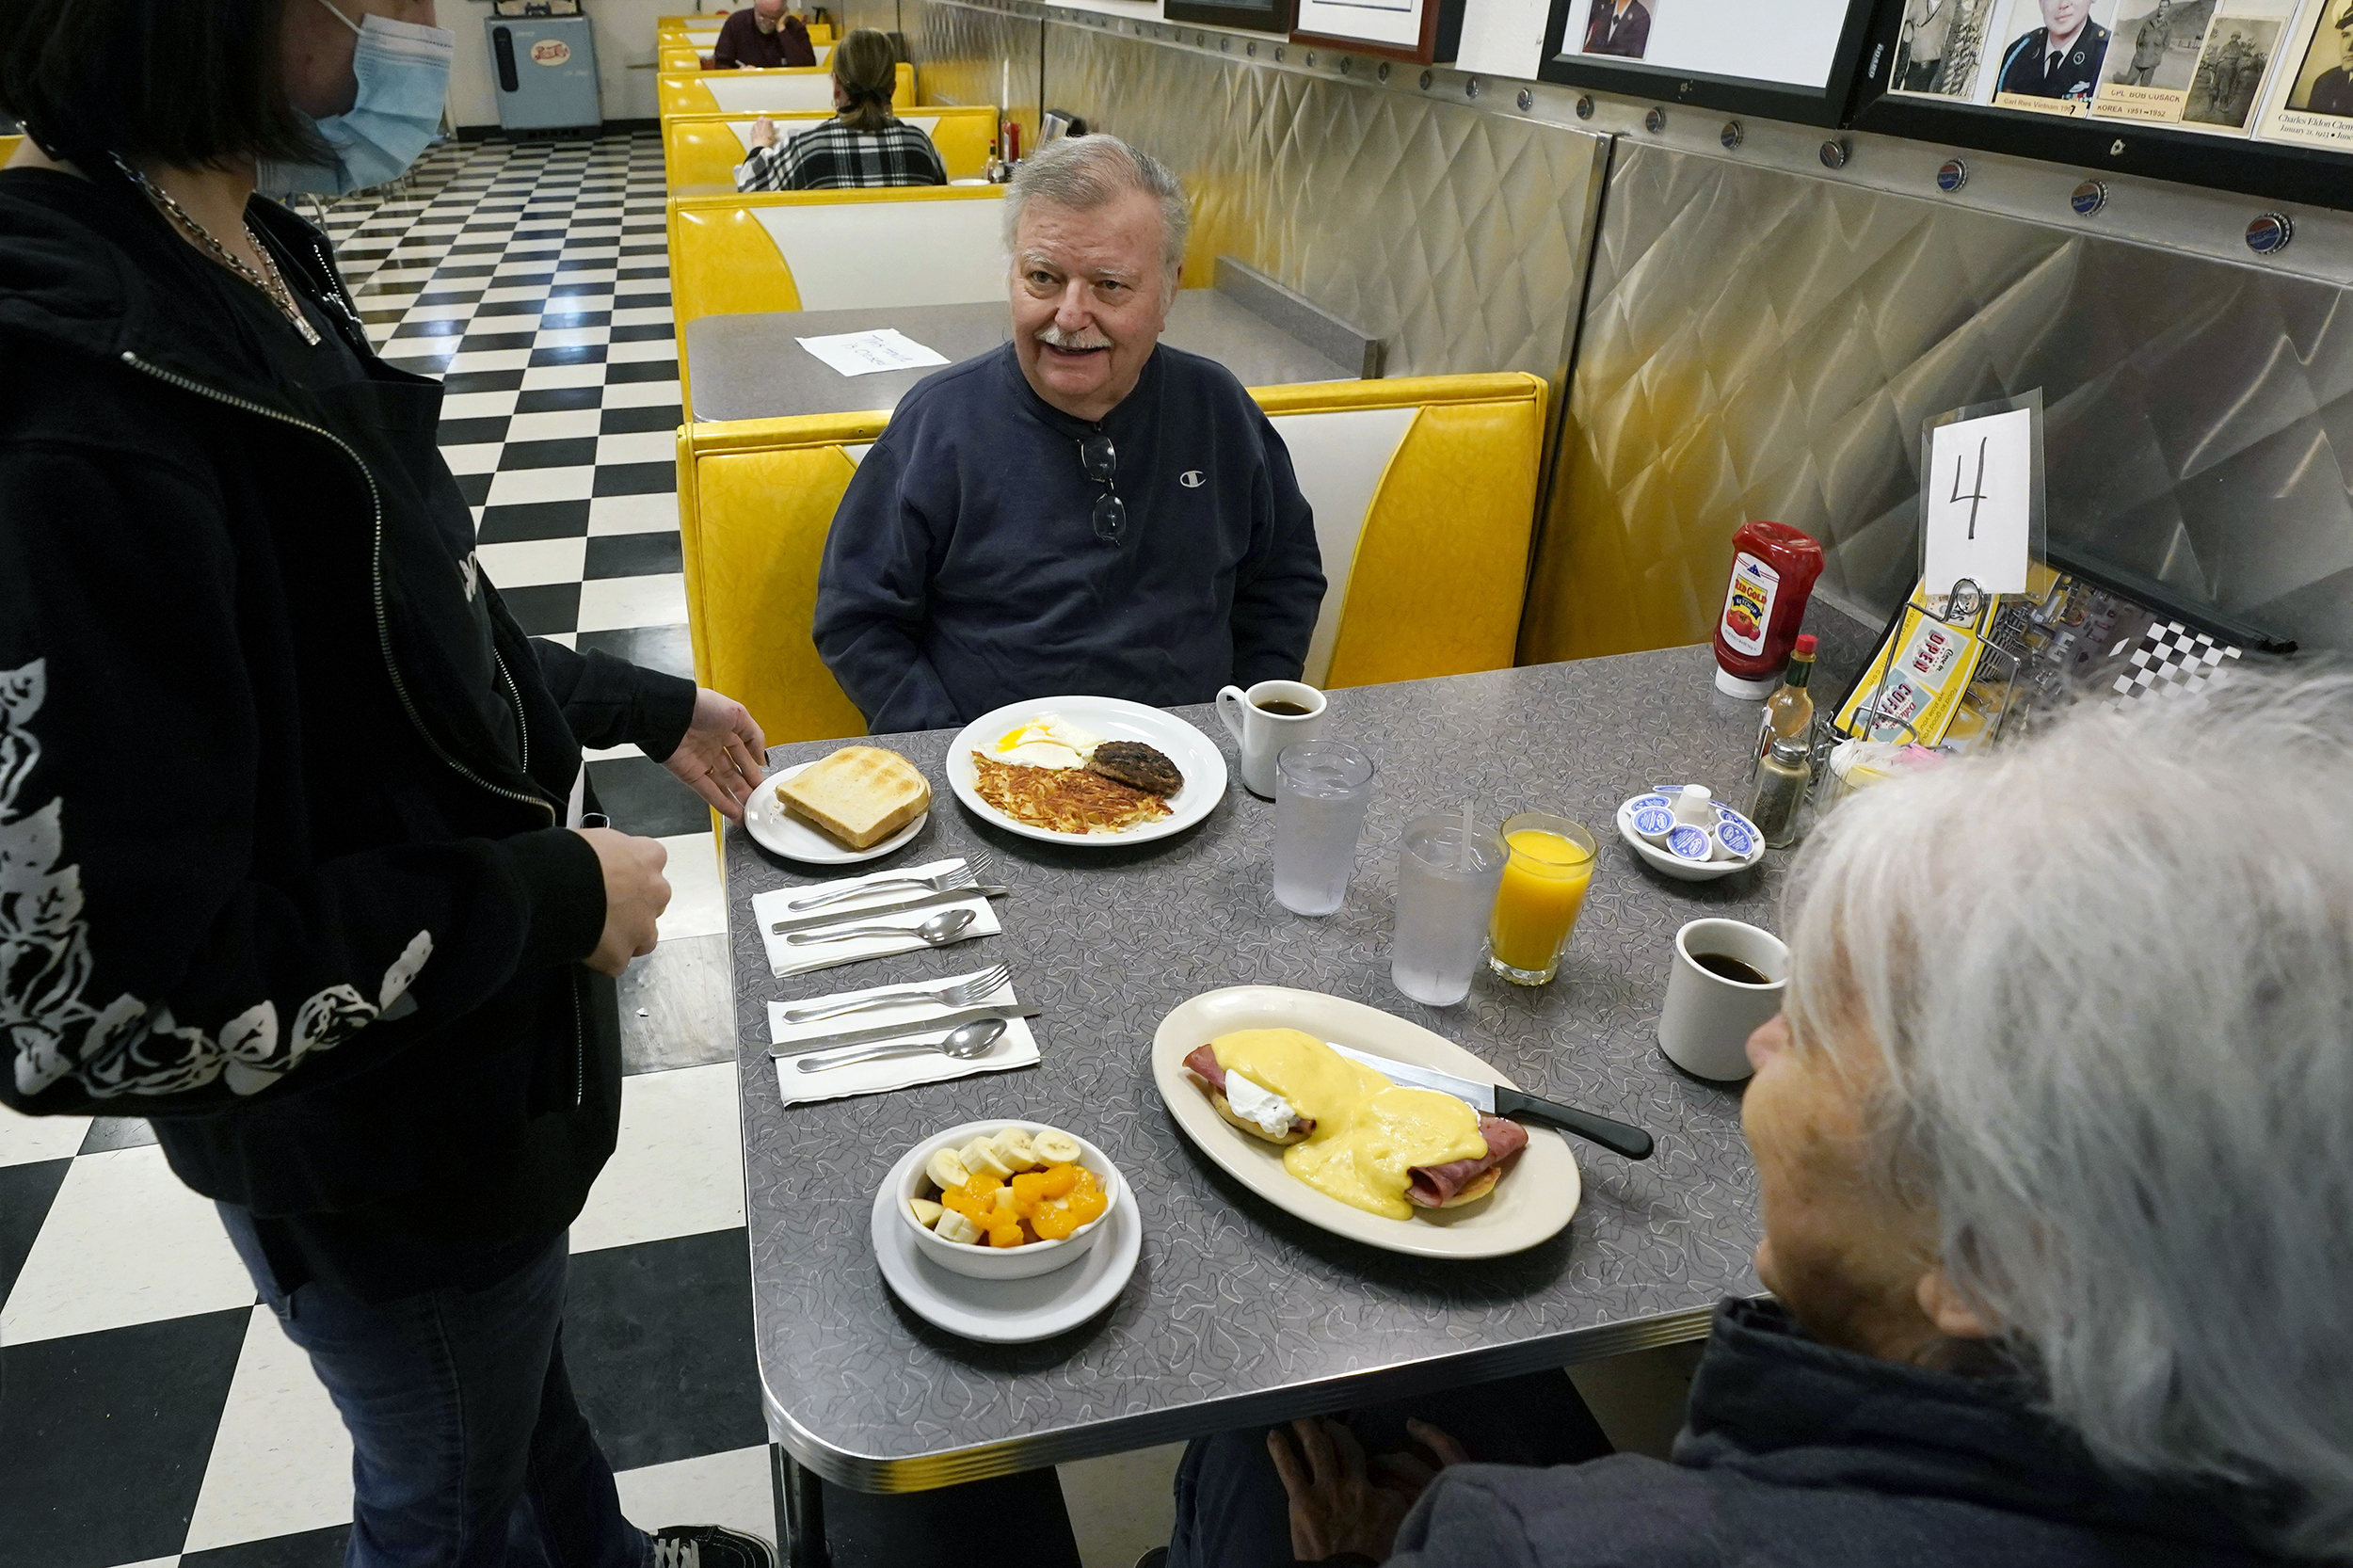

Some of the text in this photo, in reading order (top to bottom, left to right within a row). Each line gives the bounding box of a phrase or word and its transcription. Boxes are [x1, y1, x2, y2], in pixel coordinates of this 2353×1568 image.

[2129, 91, 2147, 100] BOB
[2149, 93, 2180, 104] CUSACK
[2033, 101, 2059, 111] Vietnam
[2097, 104, 2122, 113] KOREA
[2278, 114, 2306, 124] Charles
[2281, 124, 2304, 136] January
[1949, 436, 1988, 540] 4
[1747, 587, 1767, 604] GOLD
[1913, 632, 1945, 673] OPEN
[1945, 687, 1958, 705] Food
[1929, 711, 1942, 730] good
